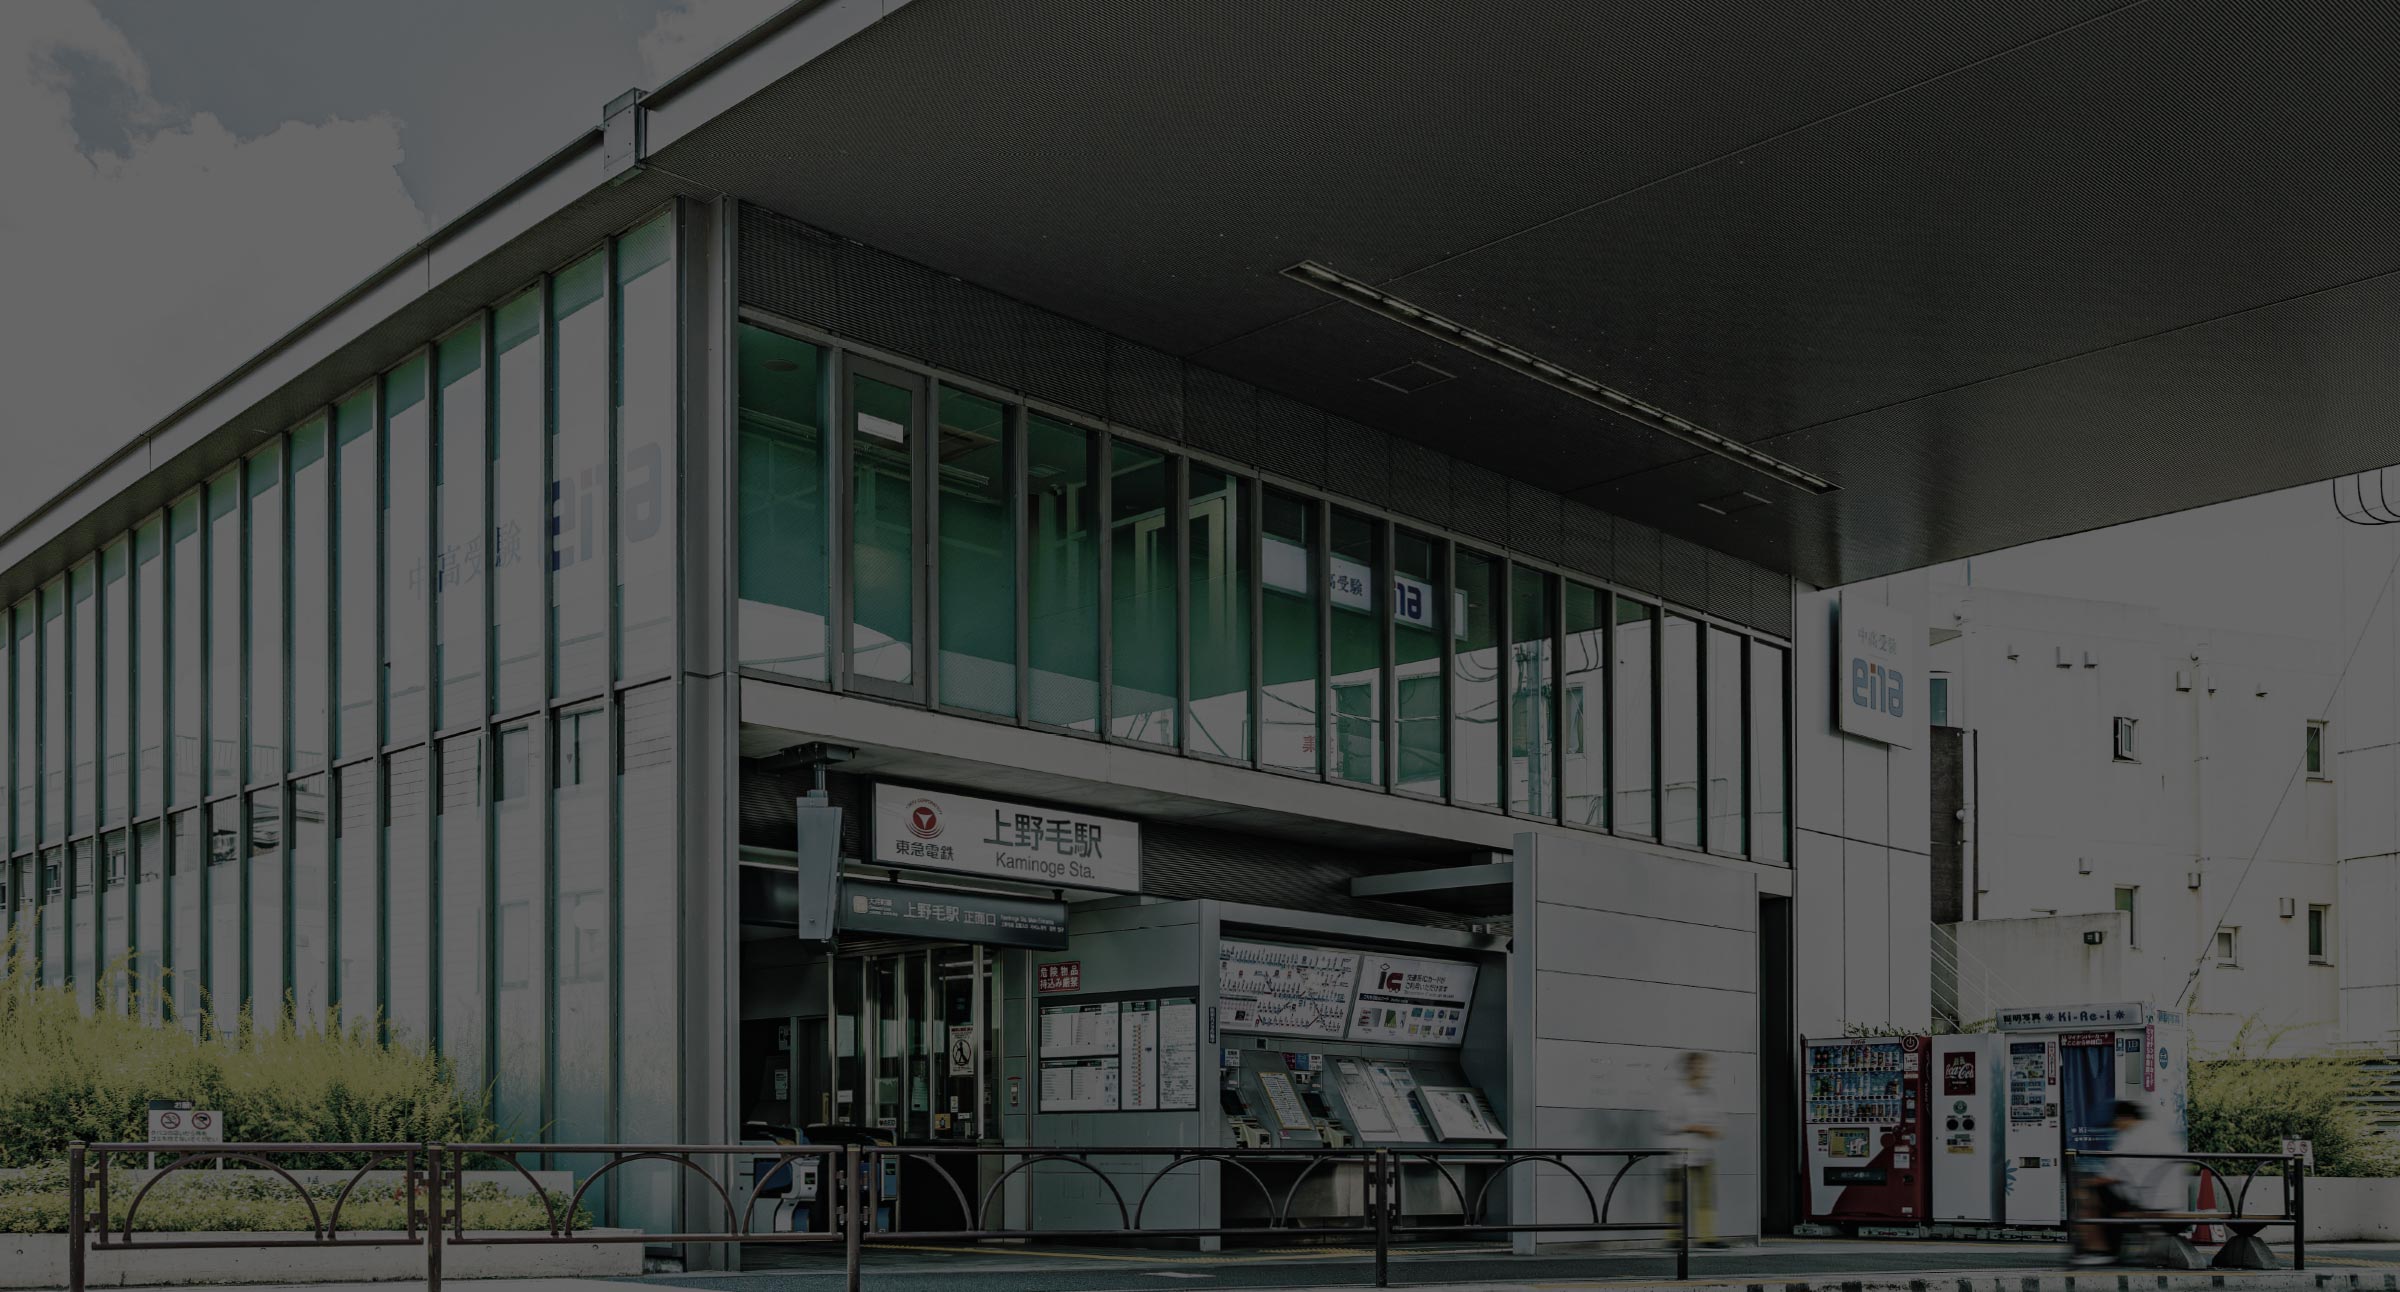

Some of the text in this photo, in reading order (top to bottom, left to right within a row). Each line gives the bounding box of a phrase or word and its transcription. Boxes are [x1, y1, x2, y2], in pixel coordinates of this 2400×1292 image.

[983, 808, 1103, 859] 上野毛駅
[895, 839, 954, 862] 東急電鉄
[995, 851, 1096, 880] Kaminoge Sta.
[903, 901, 960, 922] 上野毛駅
[963, 910, 997, 927] 正面口
[1040, 964, 1079, 978] 危険物品
[2003, 1012, 2041, 1023] 証明写真
